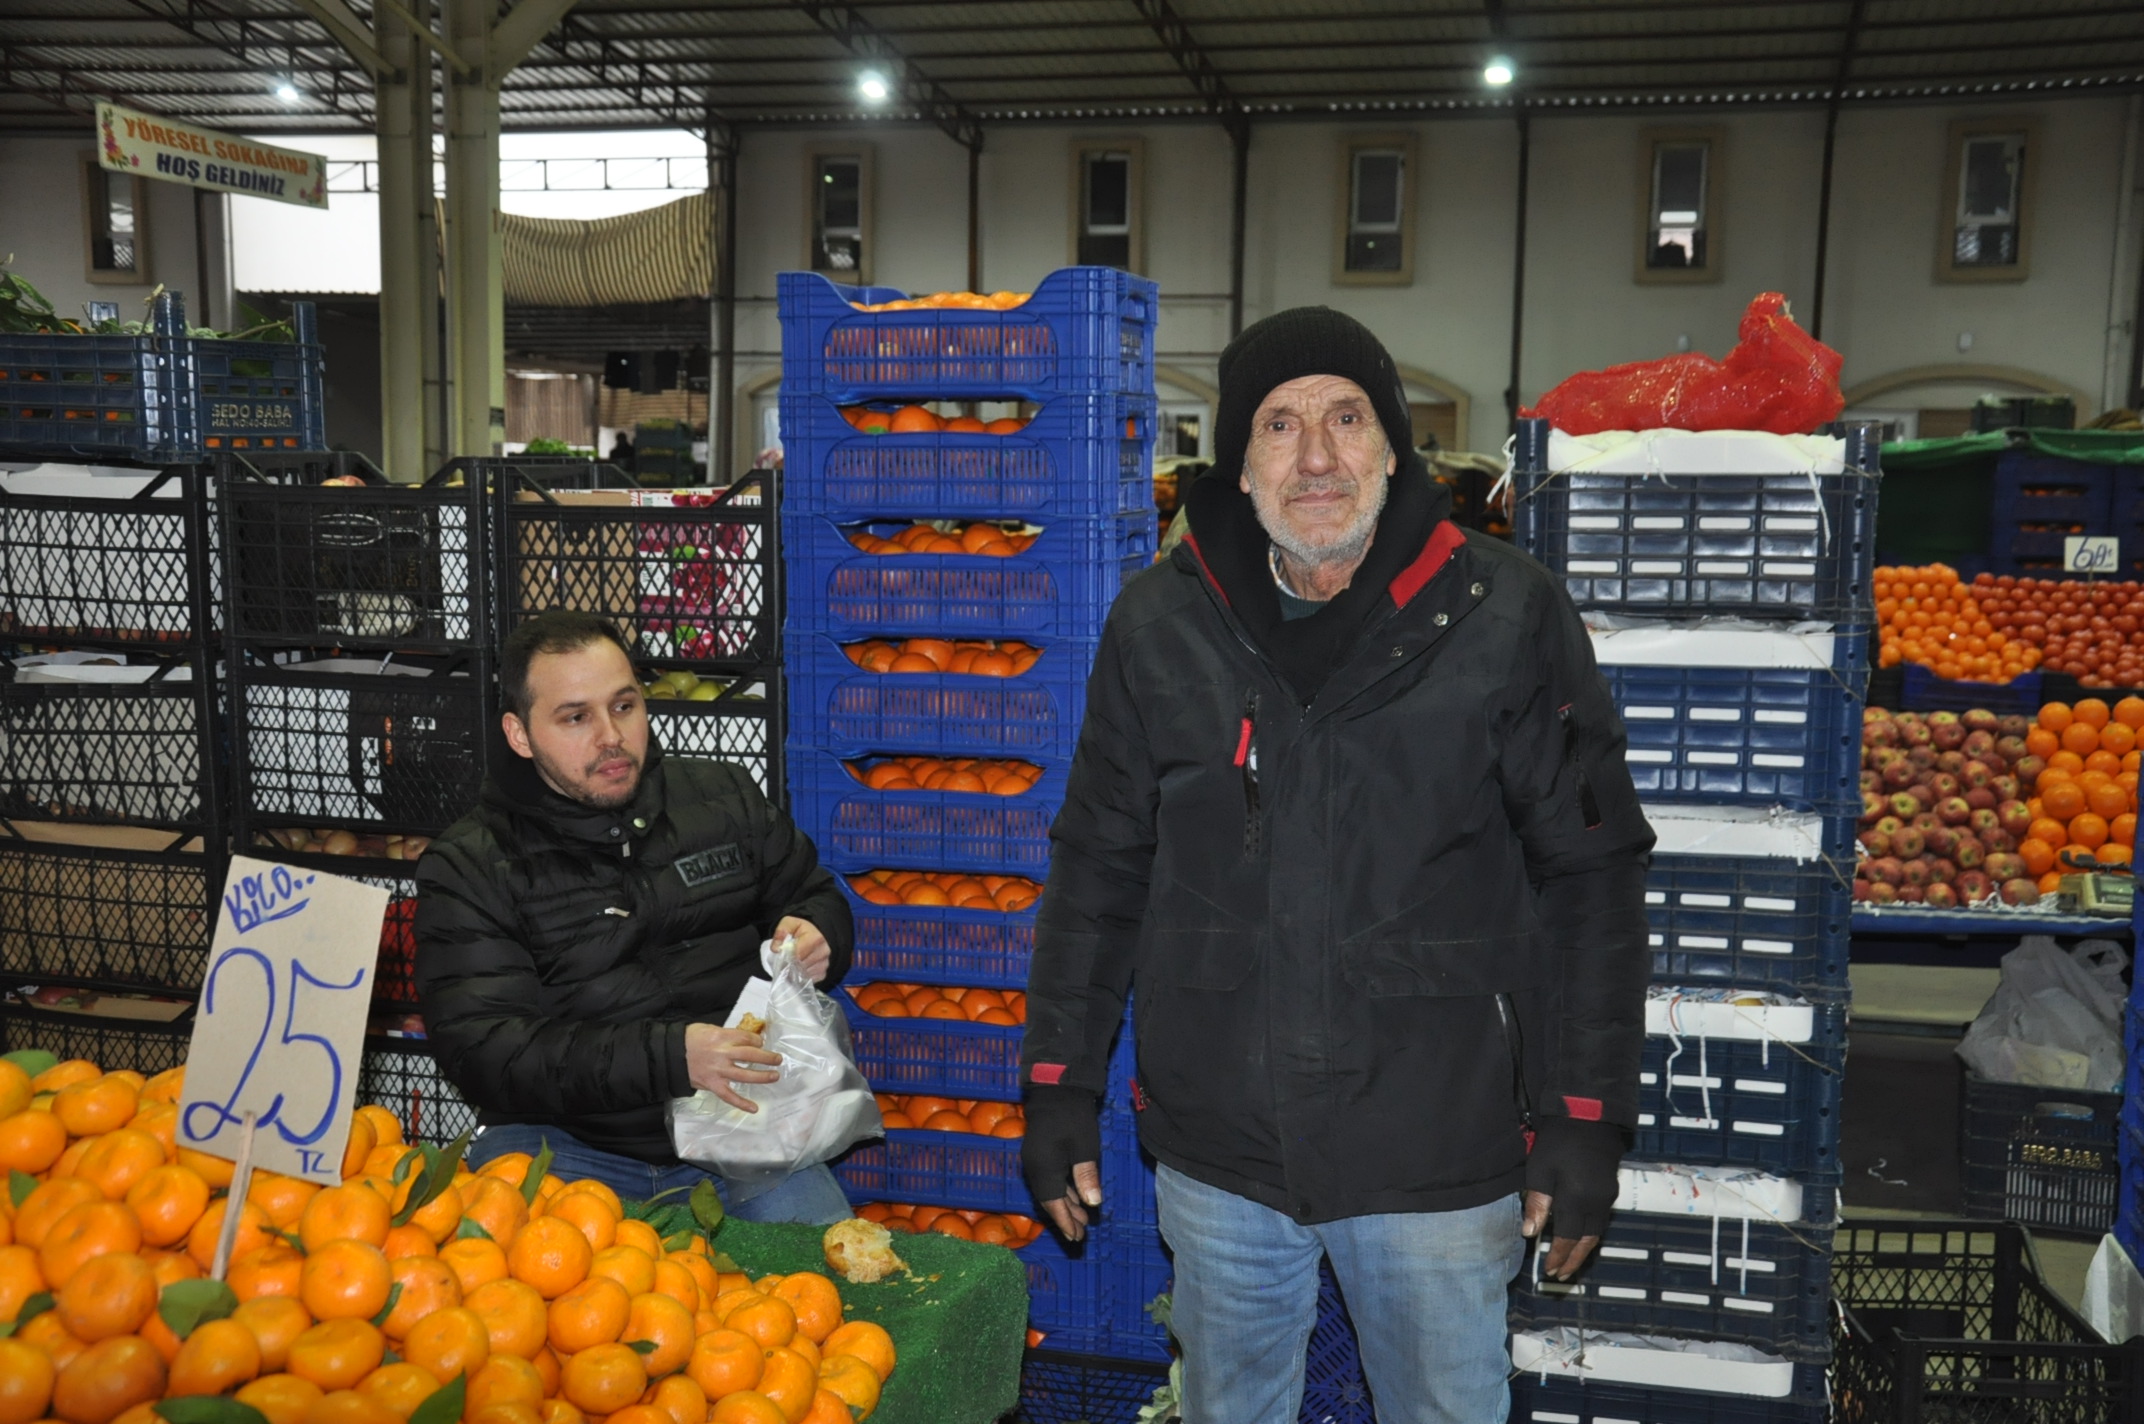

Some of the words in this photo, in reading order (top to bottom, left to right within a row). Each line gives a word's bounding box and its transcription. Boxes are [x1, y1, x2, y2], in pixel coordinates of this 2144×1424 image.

[123, 117, 211, 156] YÖRESEL
[213, 139, 309, 177] SOKAĞINA
[156, 153, 201, 183] HOŞ
[205, 163, 285, 197] GELDİNİZ
[211, 404, 251, 418] SEDO
[255, 405, 292, 419] BABA
[680, 847, 740, 882] BLACK
[183, 947, 365, 1146] 25
[296, 1149, 333, 1174] TL
